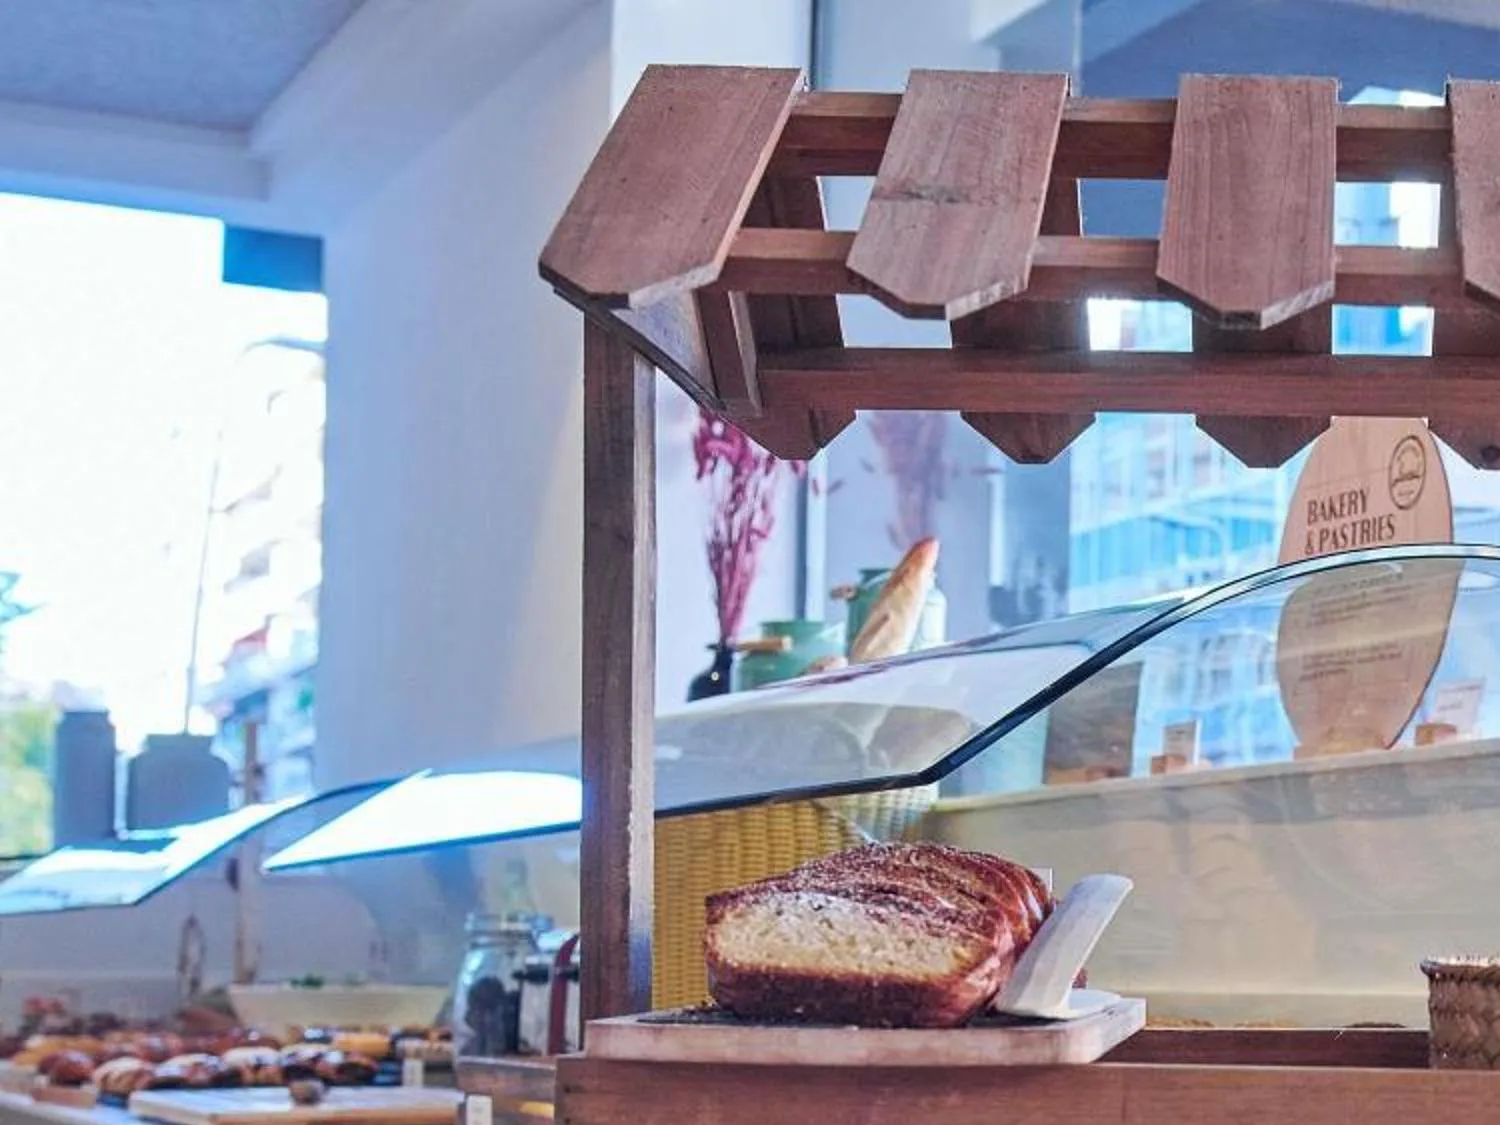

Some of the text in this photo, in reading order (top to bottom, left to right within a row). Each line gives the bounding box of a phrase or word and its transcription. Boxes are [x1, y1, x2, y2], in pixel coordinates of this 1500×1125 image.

[1306, 487, 1369, 524] BAKERY
[1305, 514, 1396, 555] & PASTRIES
